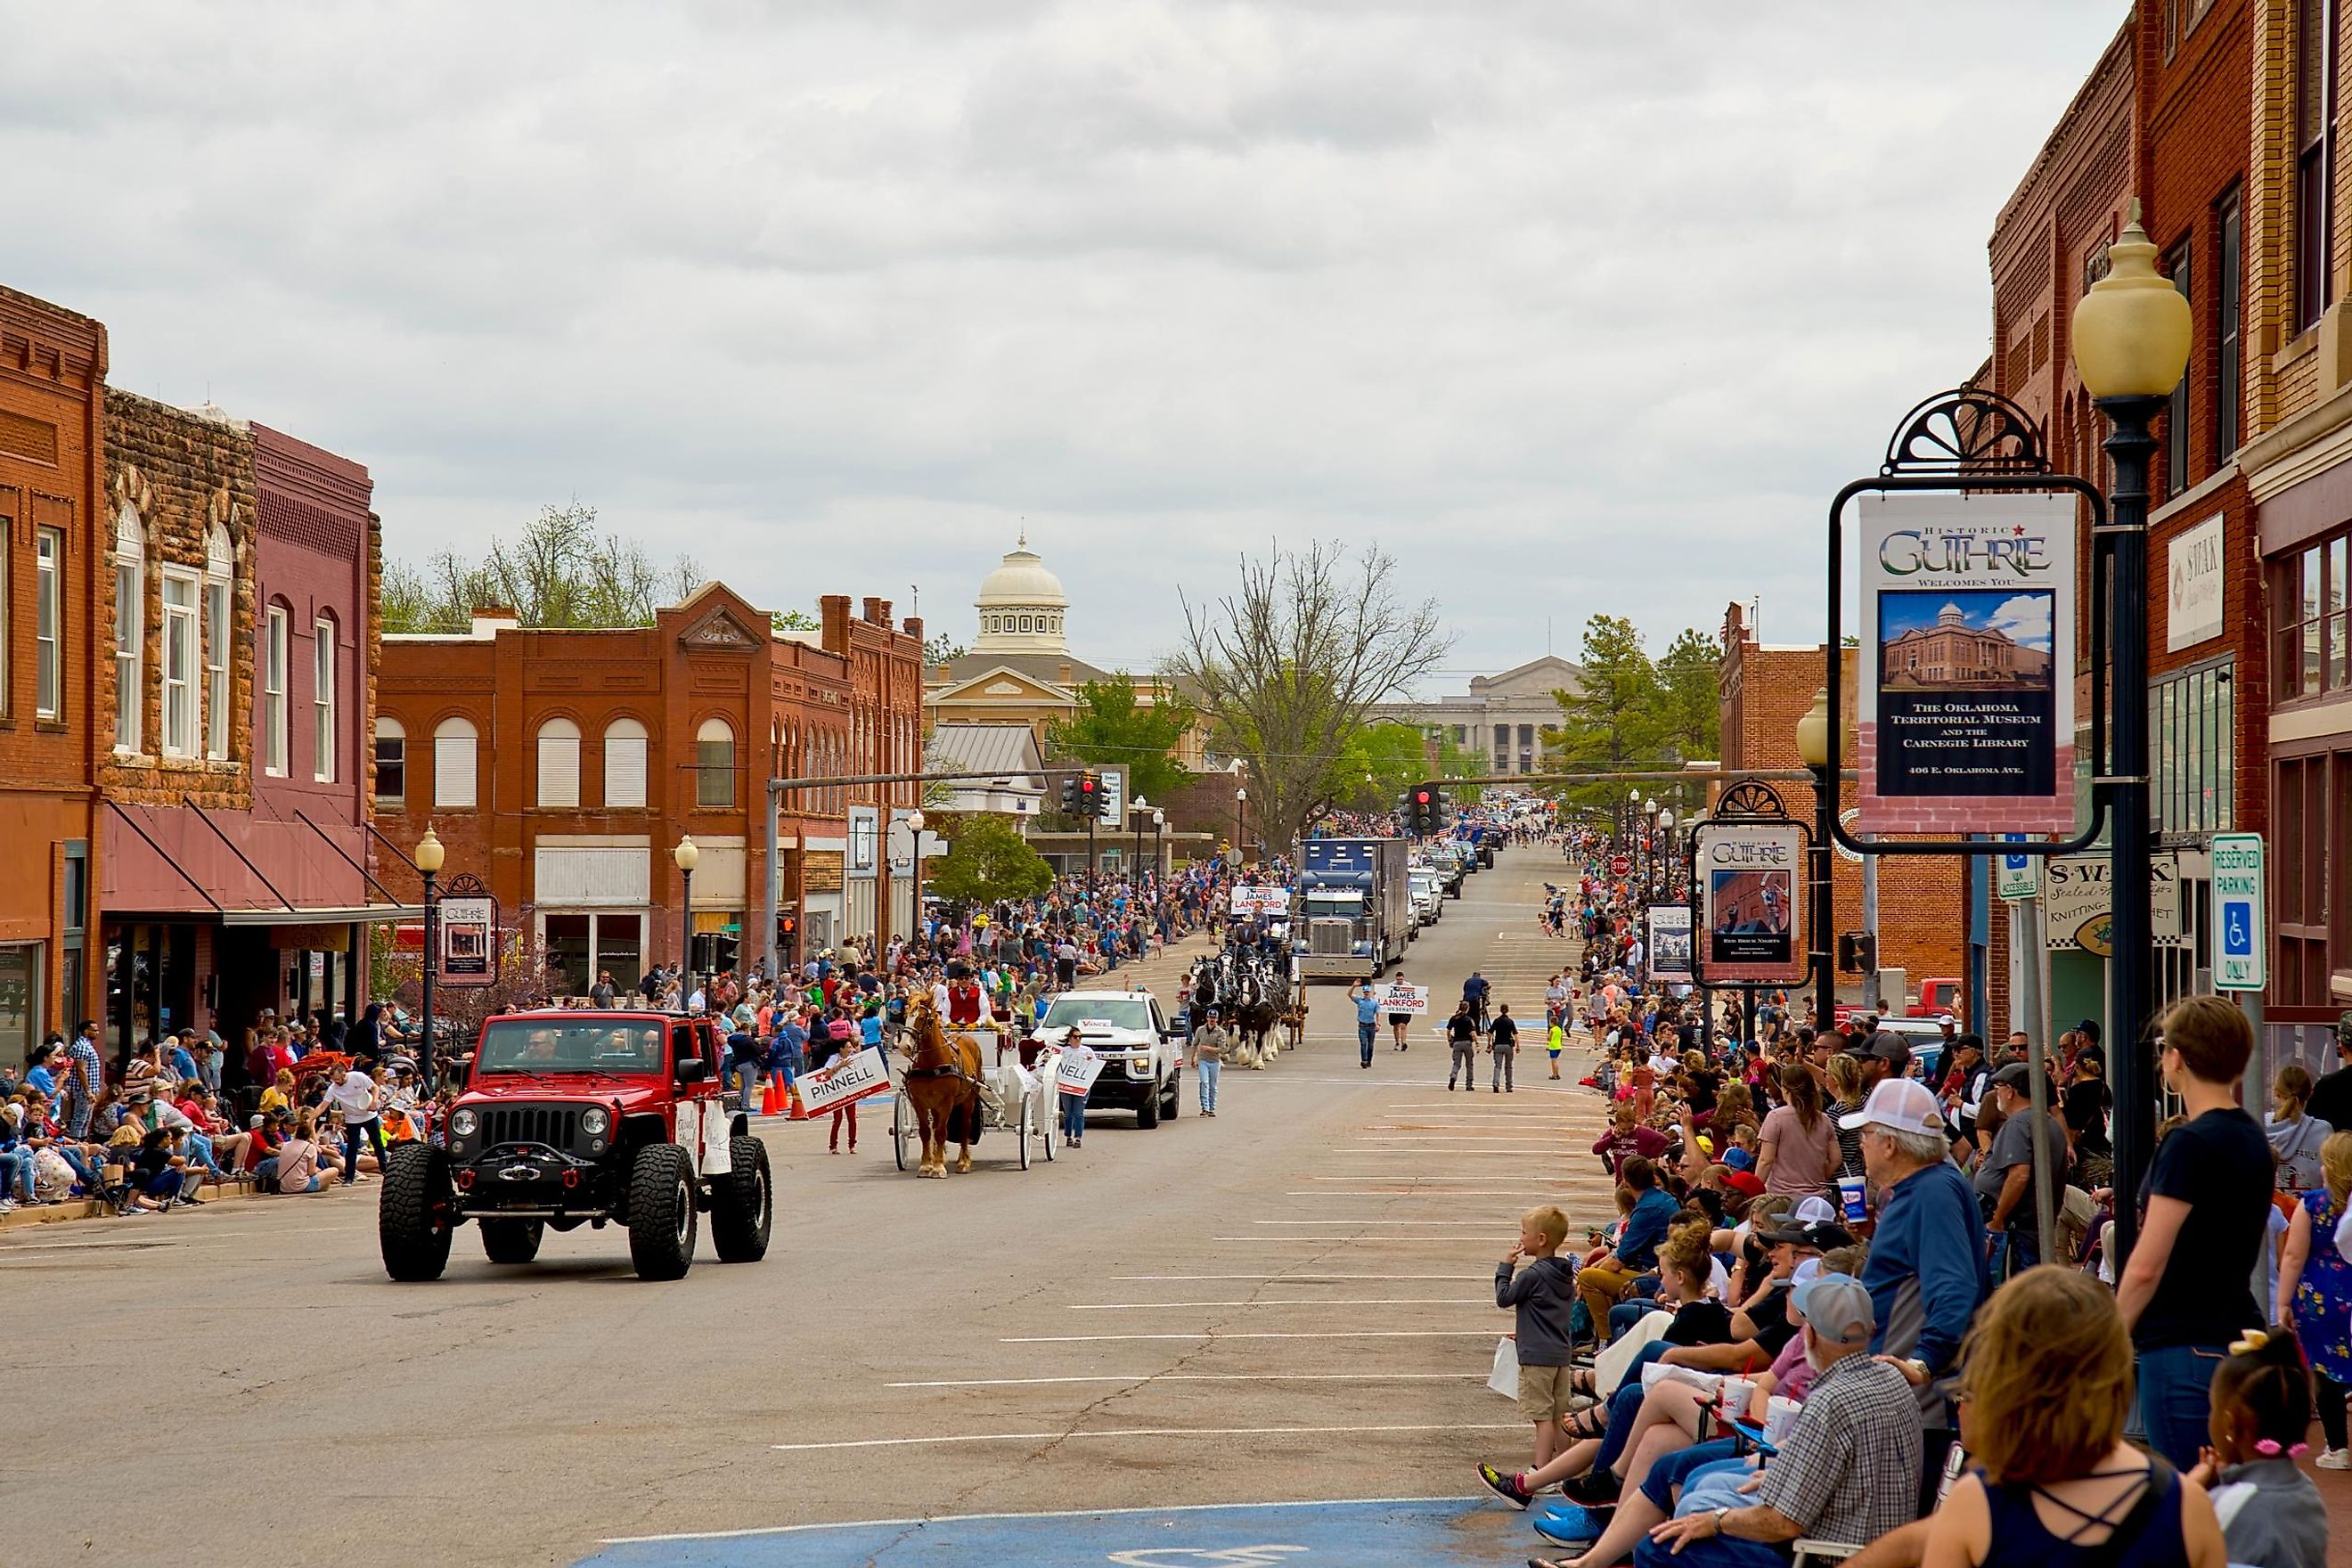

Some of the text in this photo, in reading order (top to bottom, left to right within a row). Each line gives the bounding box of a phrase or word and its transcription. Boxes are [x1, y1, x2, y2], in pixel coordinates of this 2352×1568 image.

[1924, 527, 2010, 535] HISTORIC
[1879, 529, 2053, 577] GUTHRIE
[1917, 578, 2015, 587] WELCOMES YOU
[1913, 703, 2020, 713] THE OKLAHOMA
[1891, 715, 2042, 724] TERRITORIAL MUSEUM
[1902, 739, 2029, 747] CARNEGIE LIBRARY
[1908, 766, 2024, 774] 406 E. OKLAHOMA AVE.
[1711, 842, 1789, 865] GUTHRIE
[2215, 850, 2258, 869] RESERVED
[1612, 862, 1629, 870] STOP
[2001, 880, 2036, 893] ACCESSIBLE
[2217, 876, 2256, 895] PARKING
[1245, 891, 1273, 901] JAMES
[2226, 960, 2251, 980] ONLY
[1387, 989, 1416, 1000] JAMES
[1377, 998, 1425, 1008] LANKFORD
[1056, 1062, 1086, 1081] NELL
[811, 1067, 874, 1099] PINNELL
